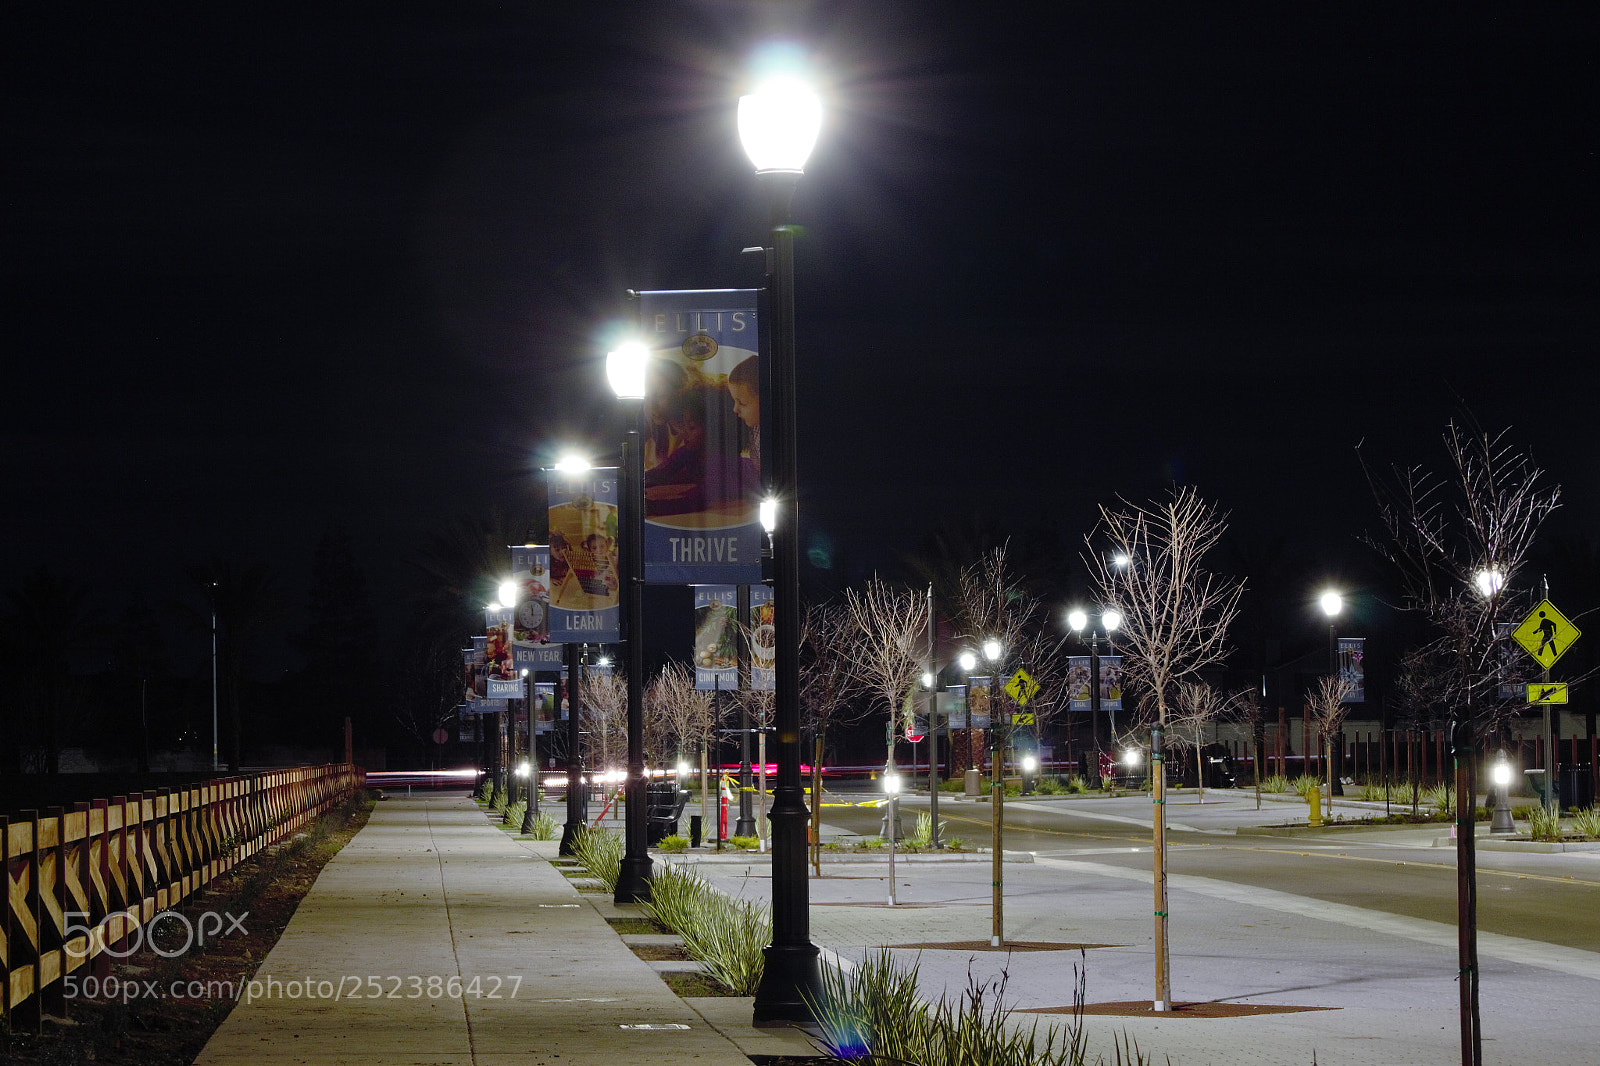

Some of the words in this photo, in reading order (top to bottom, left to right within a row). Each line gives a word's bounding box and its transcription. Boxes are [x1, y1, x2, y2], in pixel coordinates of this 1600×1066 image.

[655, 312, 746, 333] ELLIS
[555, 481, 611, 494] ELLIS
[669, 537, 738, 562] THRIVE
[518, 554, 548, 565] ELLI
[699, 592, 733, 600] ELLIS
[754, 592, 774, 600] ELL
[489, 613, 512, 621] ELLI
[566, 615, 603, 630] LEARN
[516, 650, 535, 662] NEW
[539, 650, 560, 661] YEAR
[698, 672, 735, 683] CINNMON
[492, 683, 519, 693] SHARING
